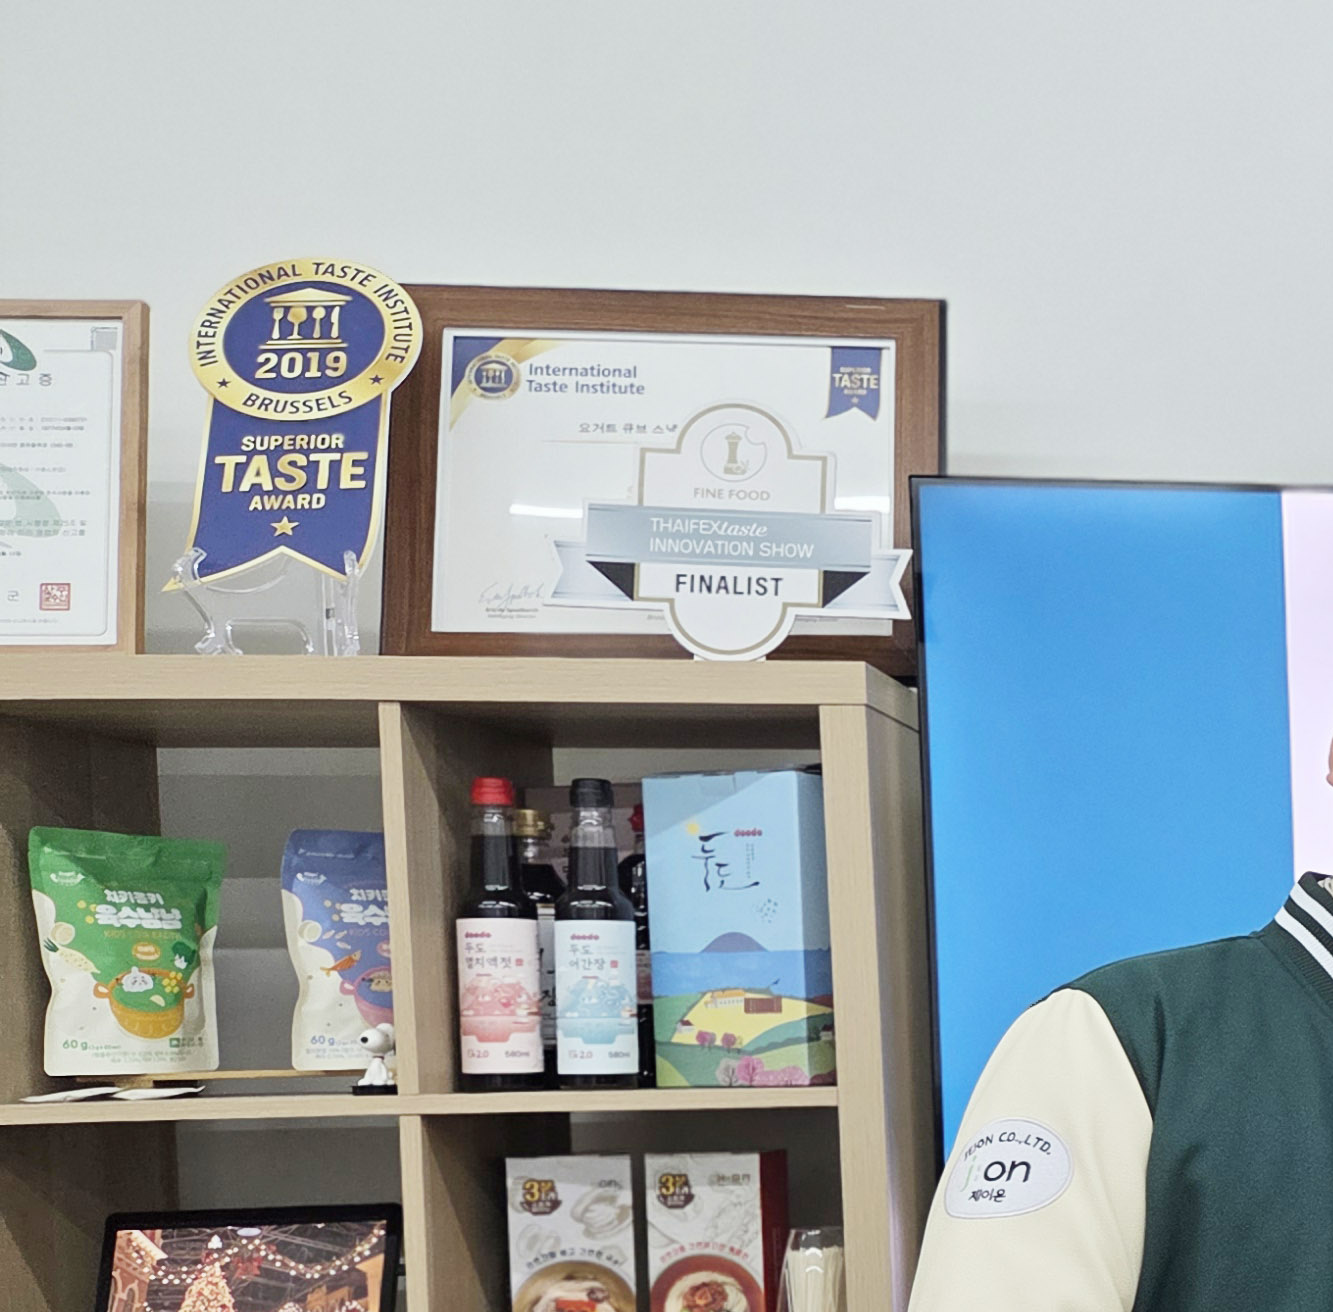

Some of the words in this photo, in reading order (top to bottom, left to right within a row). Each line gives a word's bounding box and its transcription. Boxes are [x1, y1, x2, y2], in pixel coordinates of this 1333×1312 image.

[195, 263, 302, 368] INTERNATIONAL
[312, 262, 376, 288] TASTE
[373, 283, 413, 364] INSTITUTE
[255, 351, 348, 379] 2019
[529, 363, 637, 379] International
[526, 379, 568, 394] Taste
[575, 380, 645, 395] Institute
[832, 374, 878, 388] TASTE
[242, 390, 353, 415] BRUSSELS
[240, 434, 344, 451] SUPERIOR
[215, 451, 369, 492] TASTE
[248, 493, 326, 511] AWARD
[693, 487, 725, 500] FINE
[728, 489, 771, 501] FOOD
[649, 538, 754, 556] INNOVATION
[758, 542, 815, 559] SHOW
[675, 573, 784, 597] FINALIST
[62, 1039, 78, 1050] 60
[310, 1034, 326, 1046] 60
[968, 1188, 1006, 1203] 제이온
